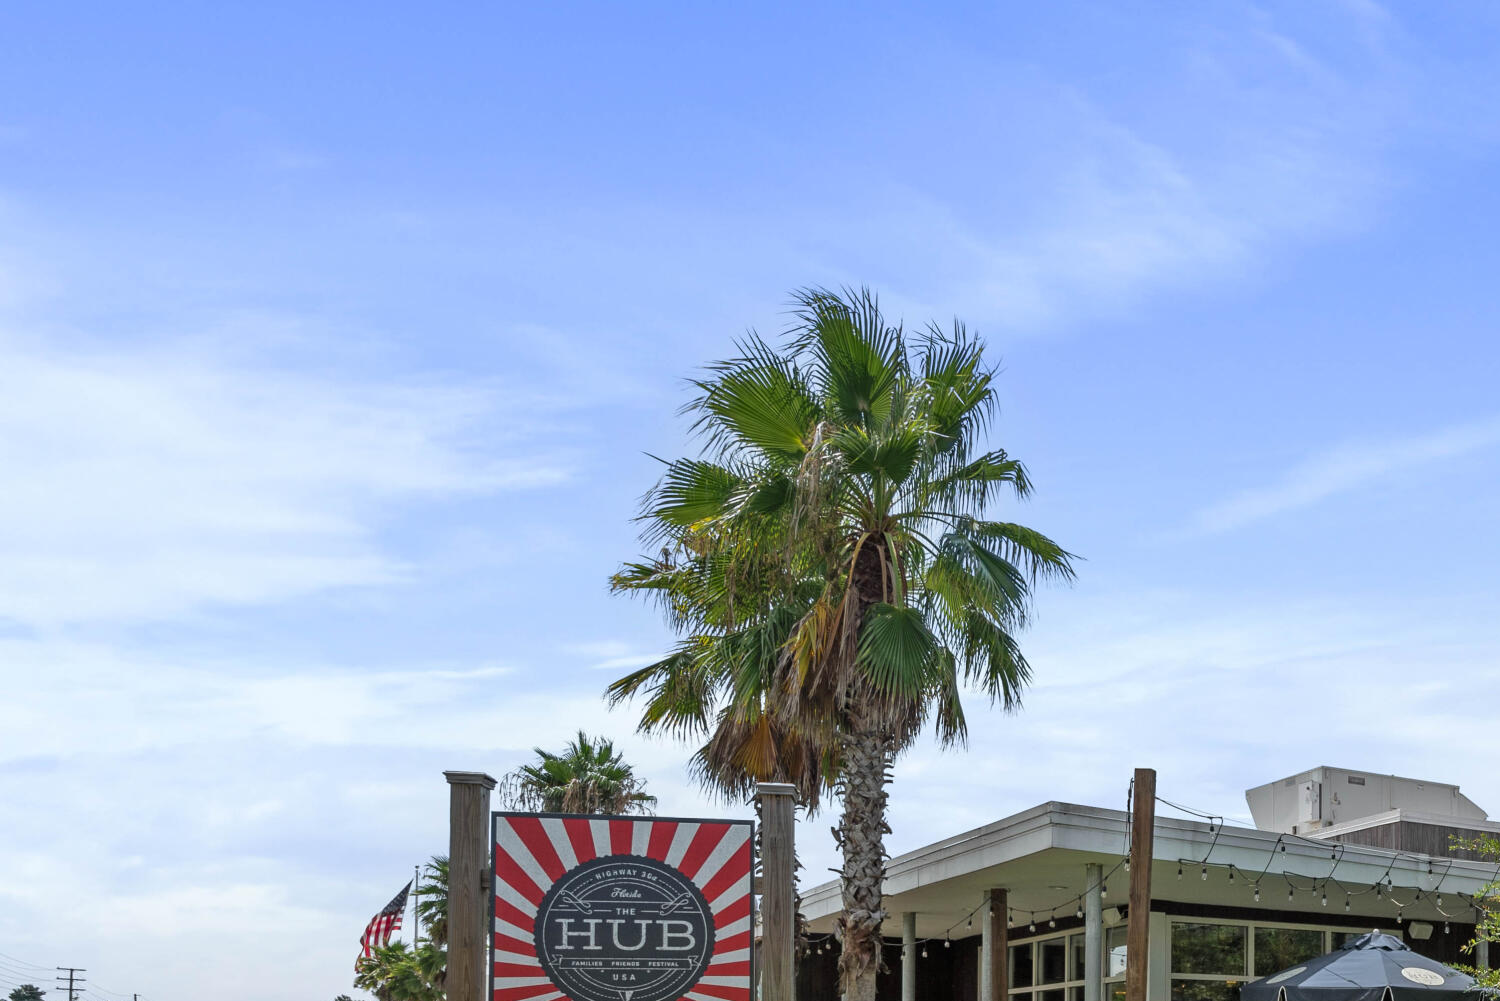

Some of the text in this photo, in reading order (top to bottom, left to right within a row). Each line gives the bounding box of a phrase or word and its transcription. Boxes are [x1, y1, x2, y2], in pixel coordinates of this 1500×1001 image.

[594, 869, 637, 880] HIGHWAY
[611, 887, 642, 898] Florida
[615, 907, 636, 916] THE
[554, 918, 696, 951] HUB
